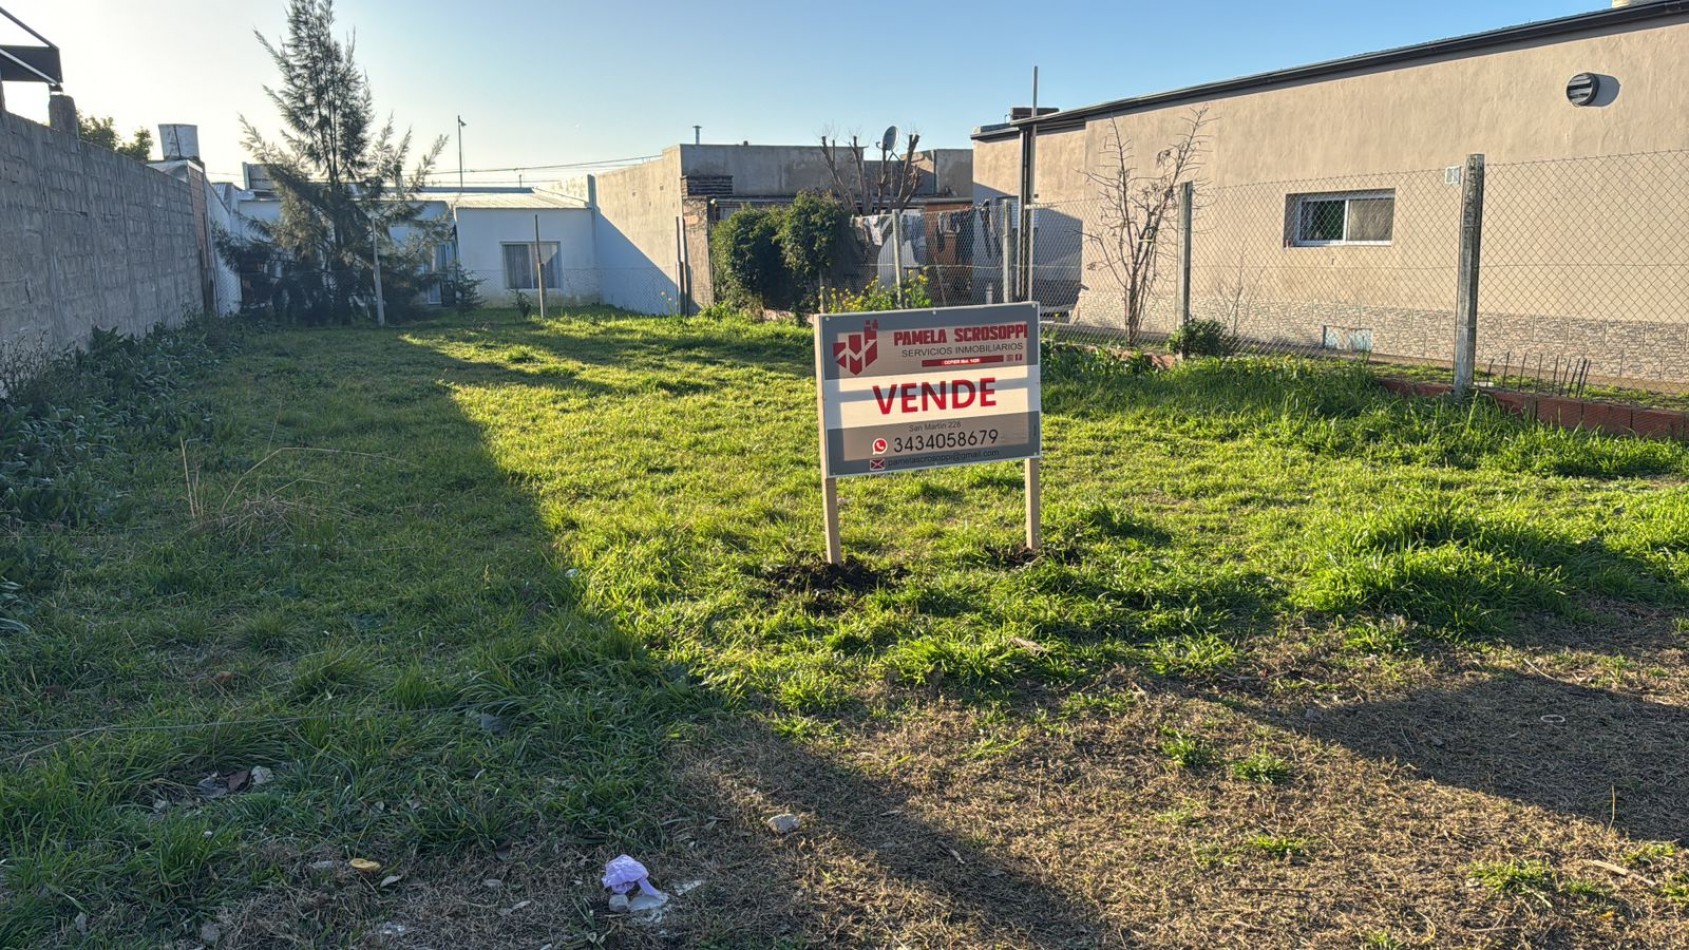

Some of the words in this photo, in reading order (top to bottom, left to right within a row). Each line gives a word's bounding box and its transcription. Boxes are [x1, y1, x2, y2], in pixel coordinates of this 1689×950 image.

[894, 329, 947, 346] PAMELA
[954, 324, 1028, 342] SCROSOPPI
[902, 346, 952, 358] SERVICIOS
[955, 342, 1023, 354] INMOBILIARIOS
[873, 377, 997, 415] VENDE
[894, 429, 998, 453] 3434058679
